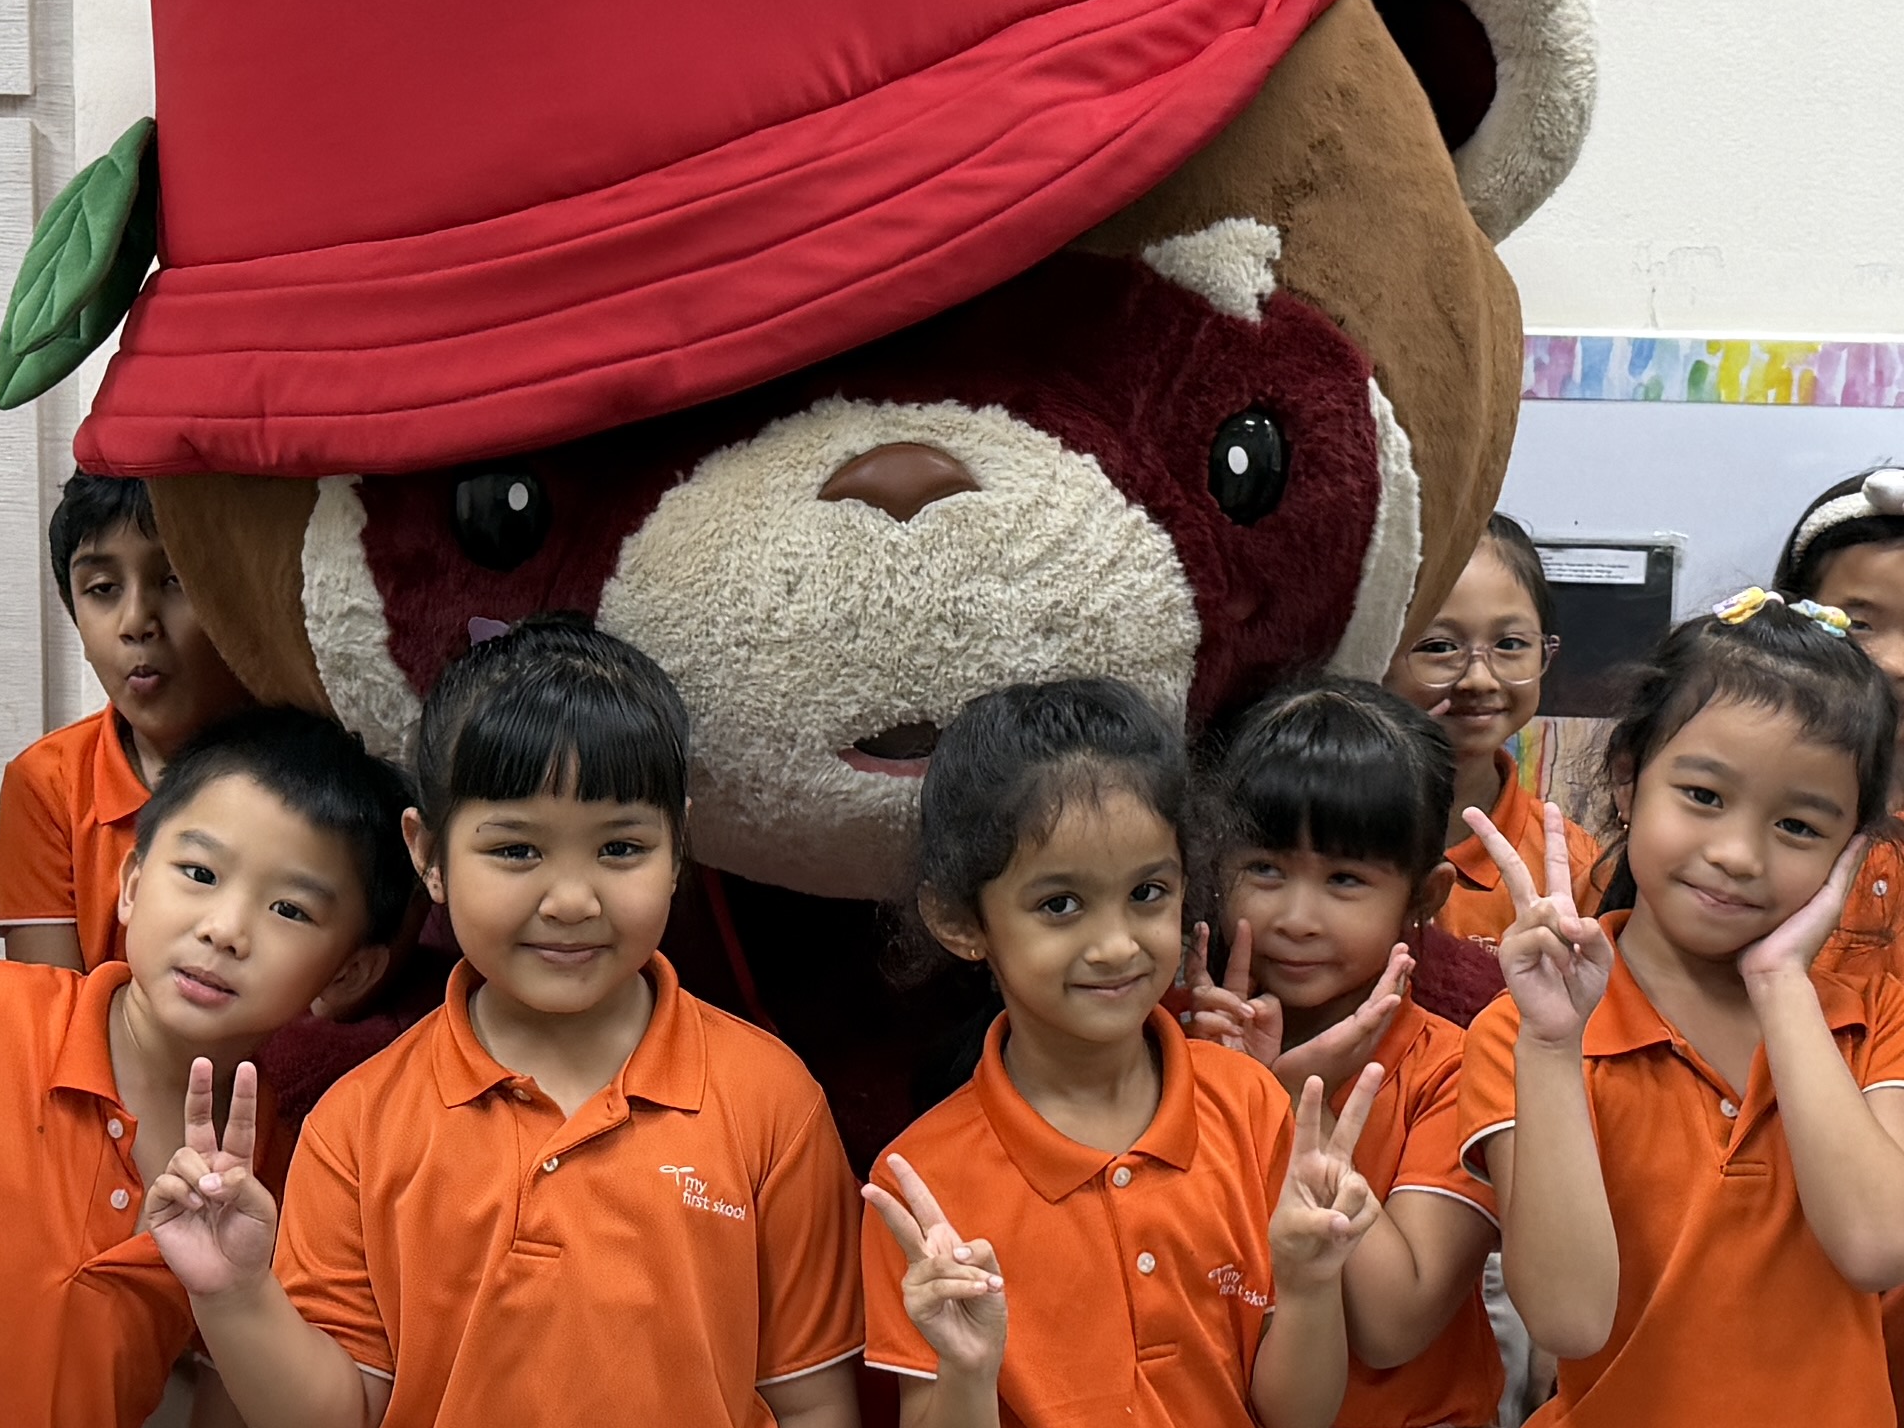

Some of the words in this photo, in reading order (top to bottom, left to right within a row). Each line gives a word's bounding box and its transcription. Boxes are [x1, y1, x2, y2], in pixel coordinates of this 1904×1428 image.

[685, 1176, 708, 1195] my
[683, 1189, 711, 1210] first
[712, 1198, 746, 1221] skool
